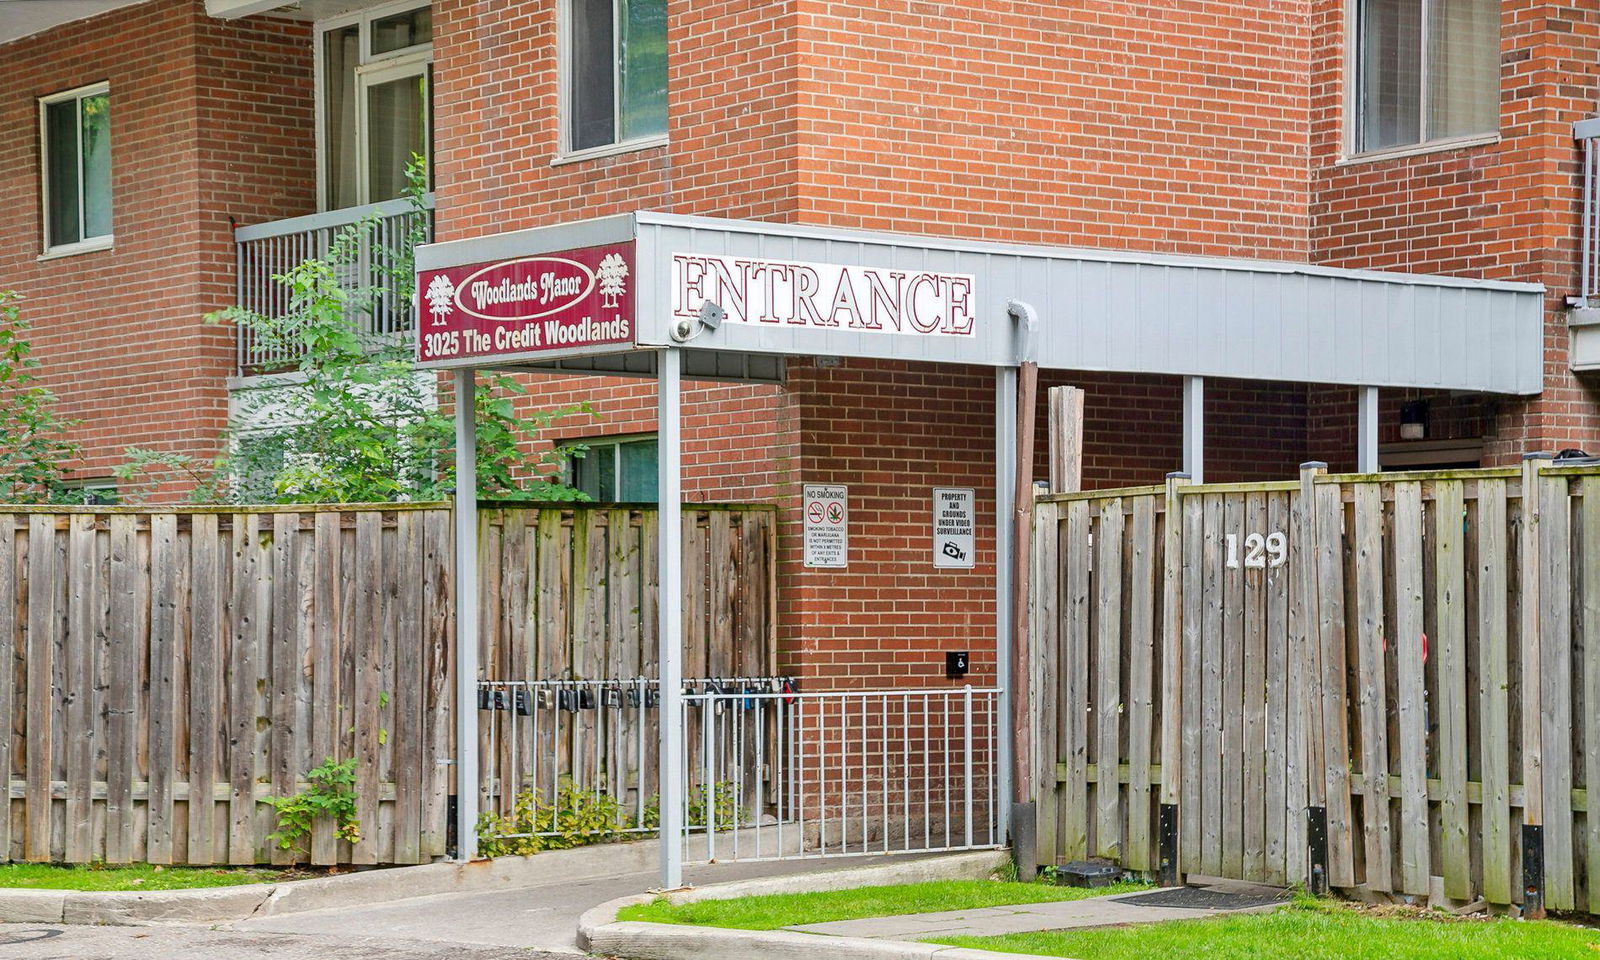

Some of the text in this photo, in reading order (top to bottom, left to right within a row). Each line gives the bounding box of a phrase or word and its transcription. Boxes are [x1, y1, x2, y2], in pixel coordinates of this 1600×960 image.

[471, 272, 582, 310] Woodlands Manor
[674, 255, 974, 335] ENTRANCE
[424, 314, 629, 357] 3025 The Credit Woodlands
[807, 490, 844, 499] NO SMOKING
[941, 492, 967, 501] PROPERTY
[949, 501, 960, 509] AND
[942, 510, 967, 518] GROUNDS
[938, 519, 971, 527] UNDER VIDEO
[936, 527, 972, 535] SURVEILLANCE
[1226, 531, 1287, 568] 129
